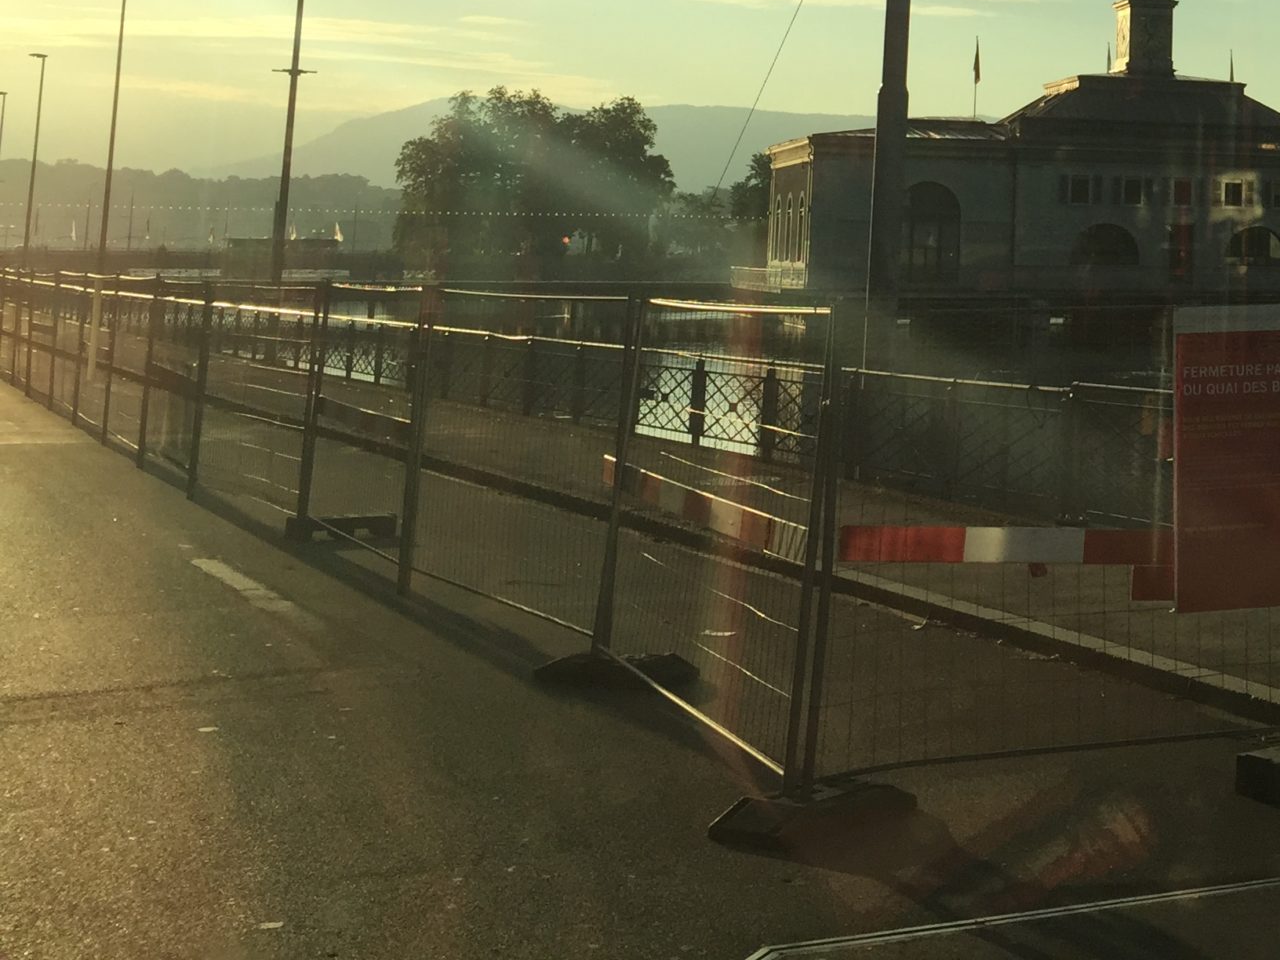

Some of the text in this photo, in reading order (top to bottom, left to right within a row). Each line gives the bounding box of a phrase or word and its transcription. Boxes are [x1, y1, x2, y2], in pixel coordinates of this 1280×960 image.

[1183, 363, 1263, 378] FERMETURE
[1183, 383, 1202, 396] DU
[1206, 382, 1238, 396] QUAI
[1242, 380, 1268, 394] DES
